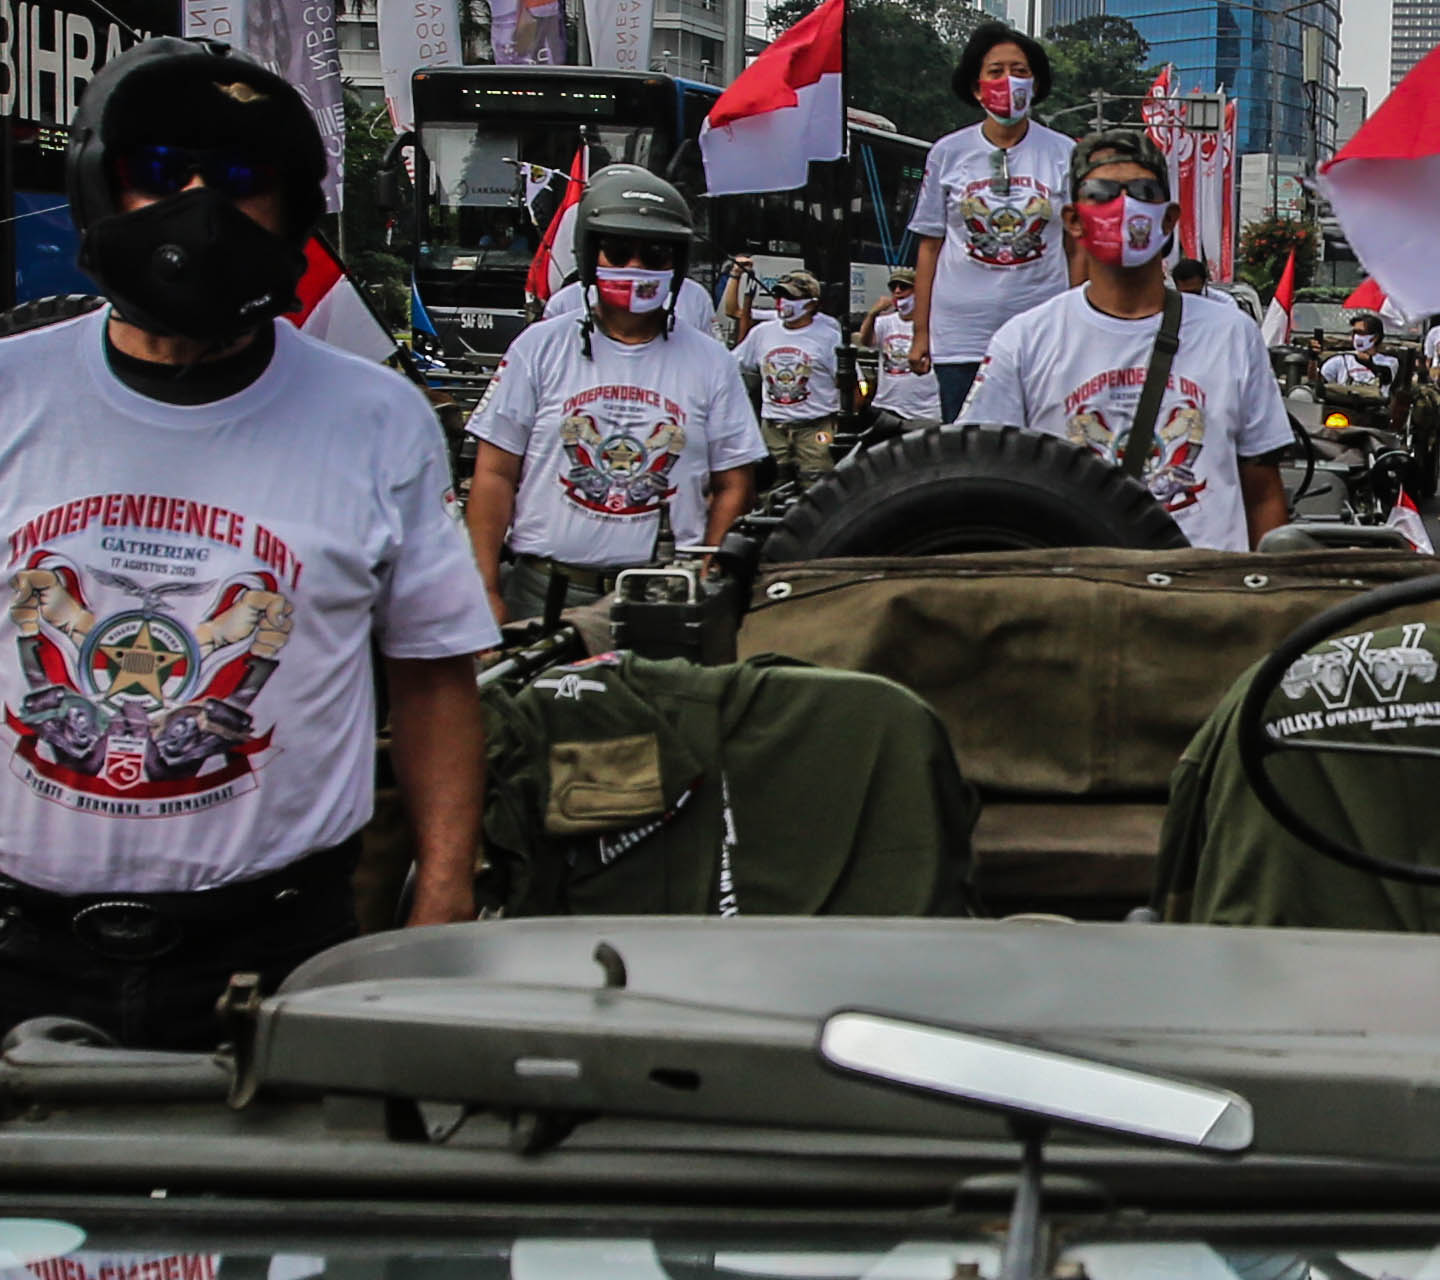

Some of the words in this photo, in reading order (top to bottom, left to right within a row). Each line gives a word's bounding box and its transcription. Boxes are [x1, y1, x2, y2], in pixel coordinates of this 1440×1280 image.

[7, 493, 244, 568] INDEPENDENCE
[254, 524, 303, 592] DAY
[101, 536, 210, 561] GATHERING
